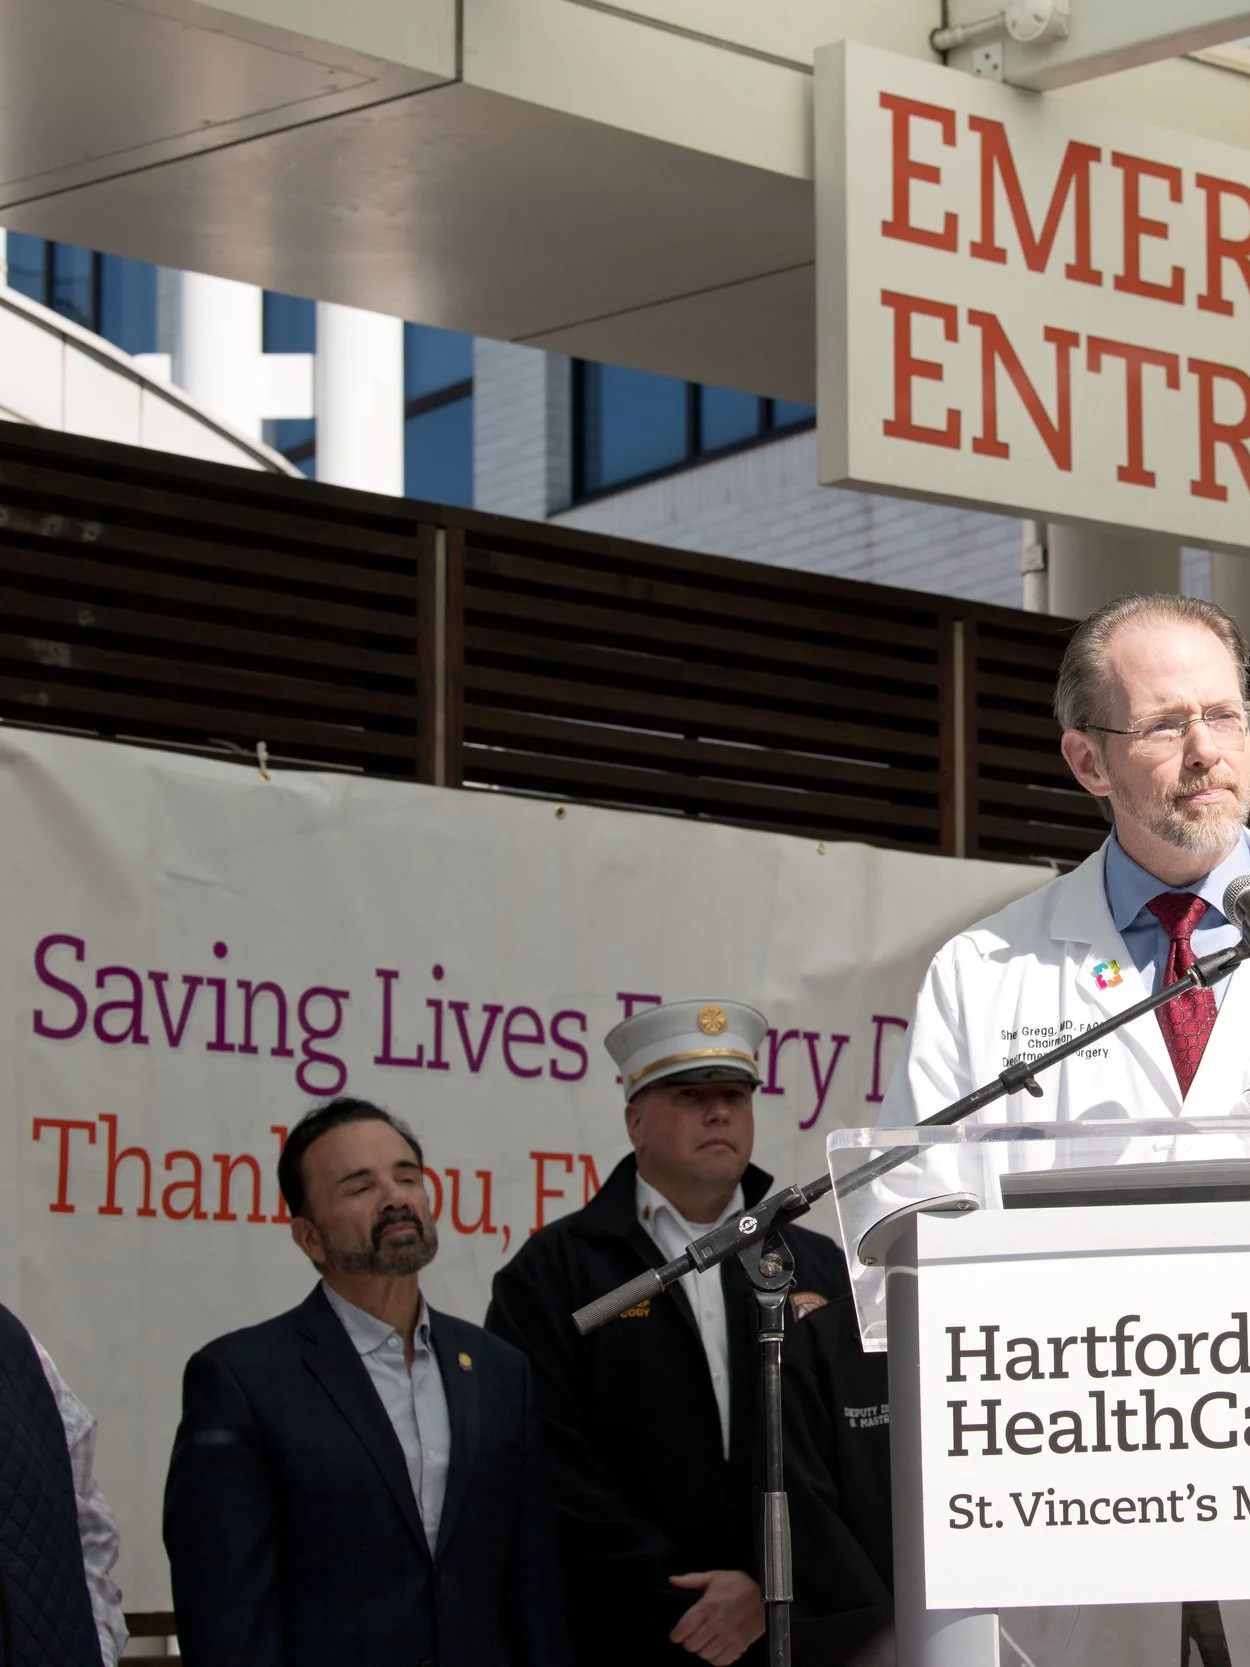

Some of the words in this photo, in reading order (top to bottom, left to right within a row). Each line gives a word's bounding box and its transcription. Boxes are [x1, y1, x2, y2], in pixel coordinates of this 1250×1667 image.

[33, 934, 349, 1096] Saving
[373, 963, 589, 1082] Lives
[1021, 1026, 1057, 1038] Gregg,
[1080, 1021, 1104, 1033] FAC
[1075, 1048, 1109, 1060] urgery
[844, 1406, 877, 1418] DEPUTY
[949, 1493, 1004, 1530] St.
[1009, 1483, 1218, 1527] Vincent's
